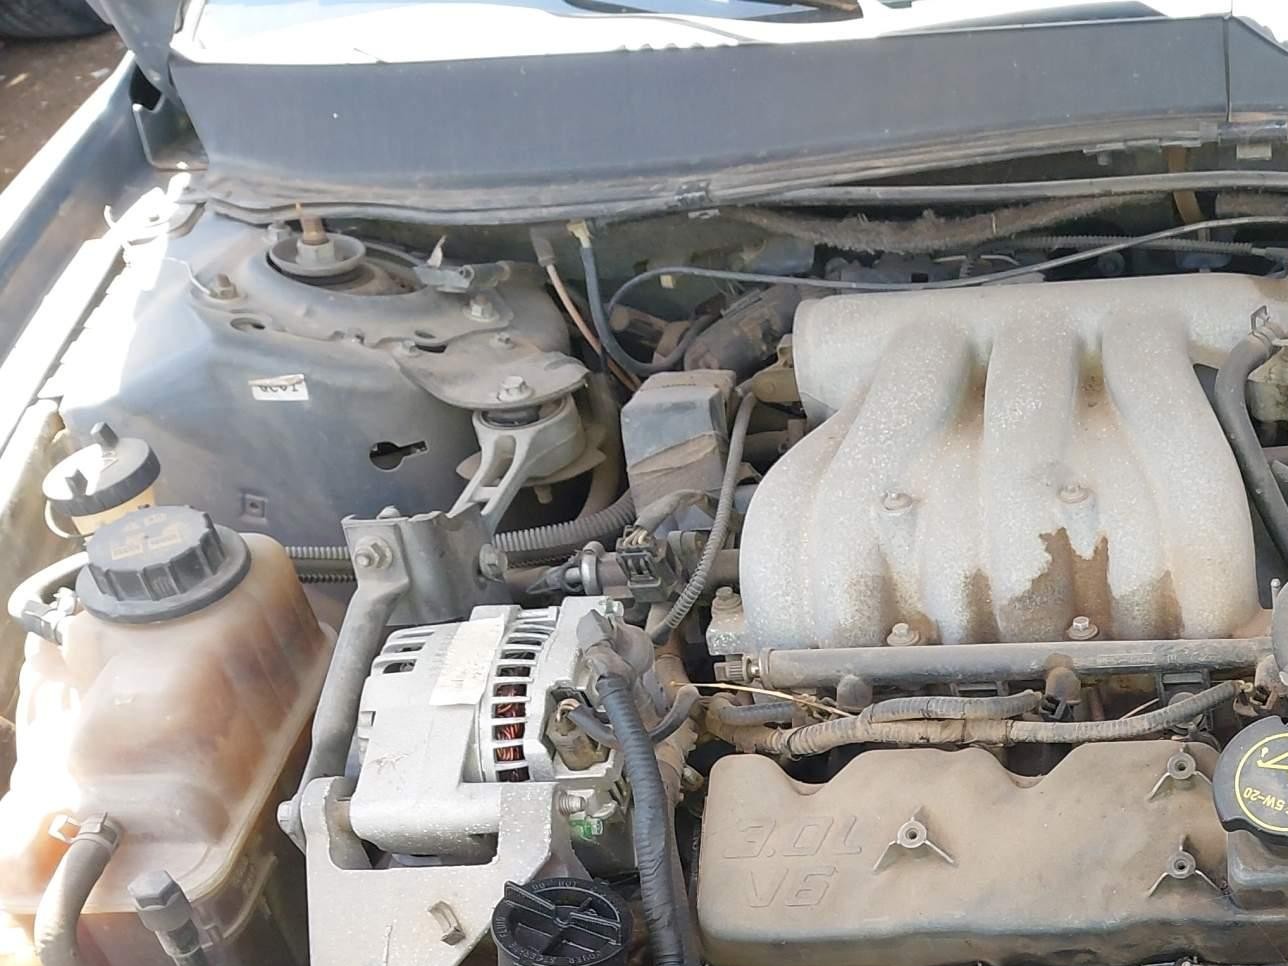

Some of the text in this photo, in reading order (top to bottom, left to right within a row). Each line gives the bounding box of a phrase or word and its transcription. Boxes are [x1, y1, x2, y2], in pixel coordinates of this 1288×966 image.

[1243, 786, 1286, 811] 5W-20
[722, 815, 864, 860] 3.0L
[746, 864, 839, 909] V6
[495, 916, 509, 939] FLUID
